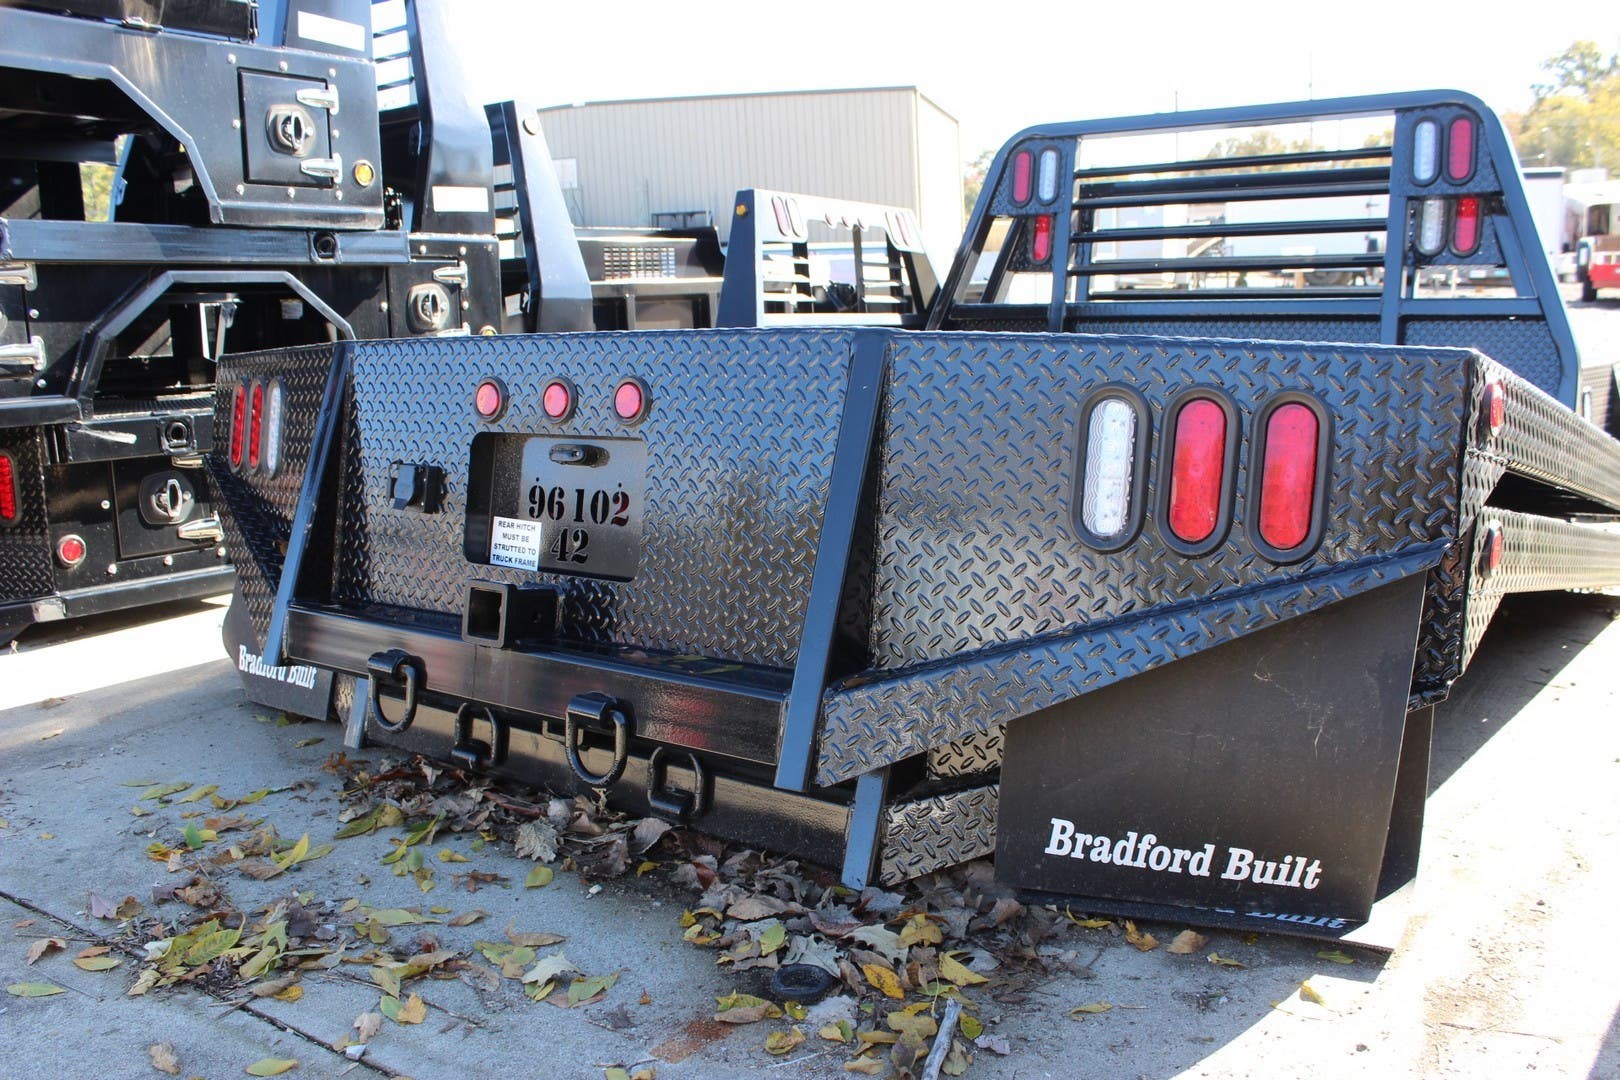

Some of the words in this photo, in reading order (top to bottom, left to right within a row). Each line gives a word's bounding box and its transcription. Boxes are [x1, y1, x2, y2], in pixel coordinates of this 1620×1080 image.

[498, 520, 515, 529] REAR
[516, 523, 536, 531] HITCH
[502, 532, 520, 541] MUST
[521, 535, 530, 543] BE
[493, 542, 526, 554] STRUTTED
[528, 548, 537, 556] TO
[551, 526, 589, 564] 42
[492, 554, 513, 564] TRUCK
[514, 557, 537, 568] FRAME
[1044, 816, 1216, 878] Bradford
[1220, 847, 1322, 890] Built
